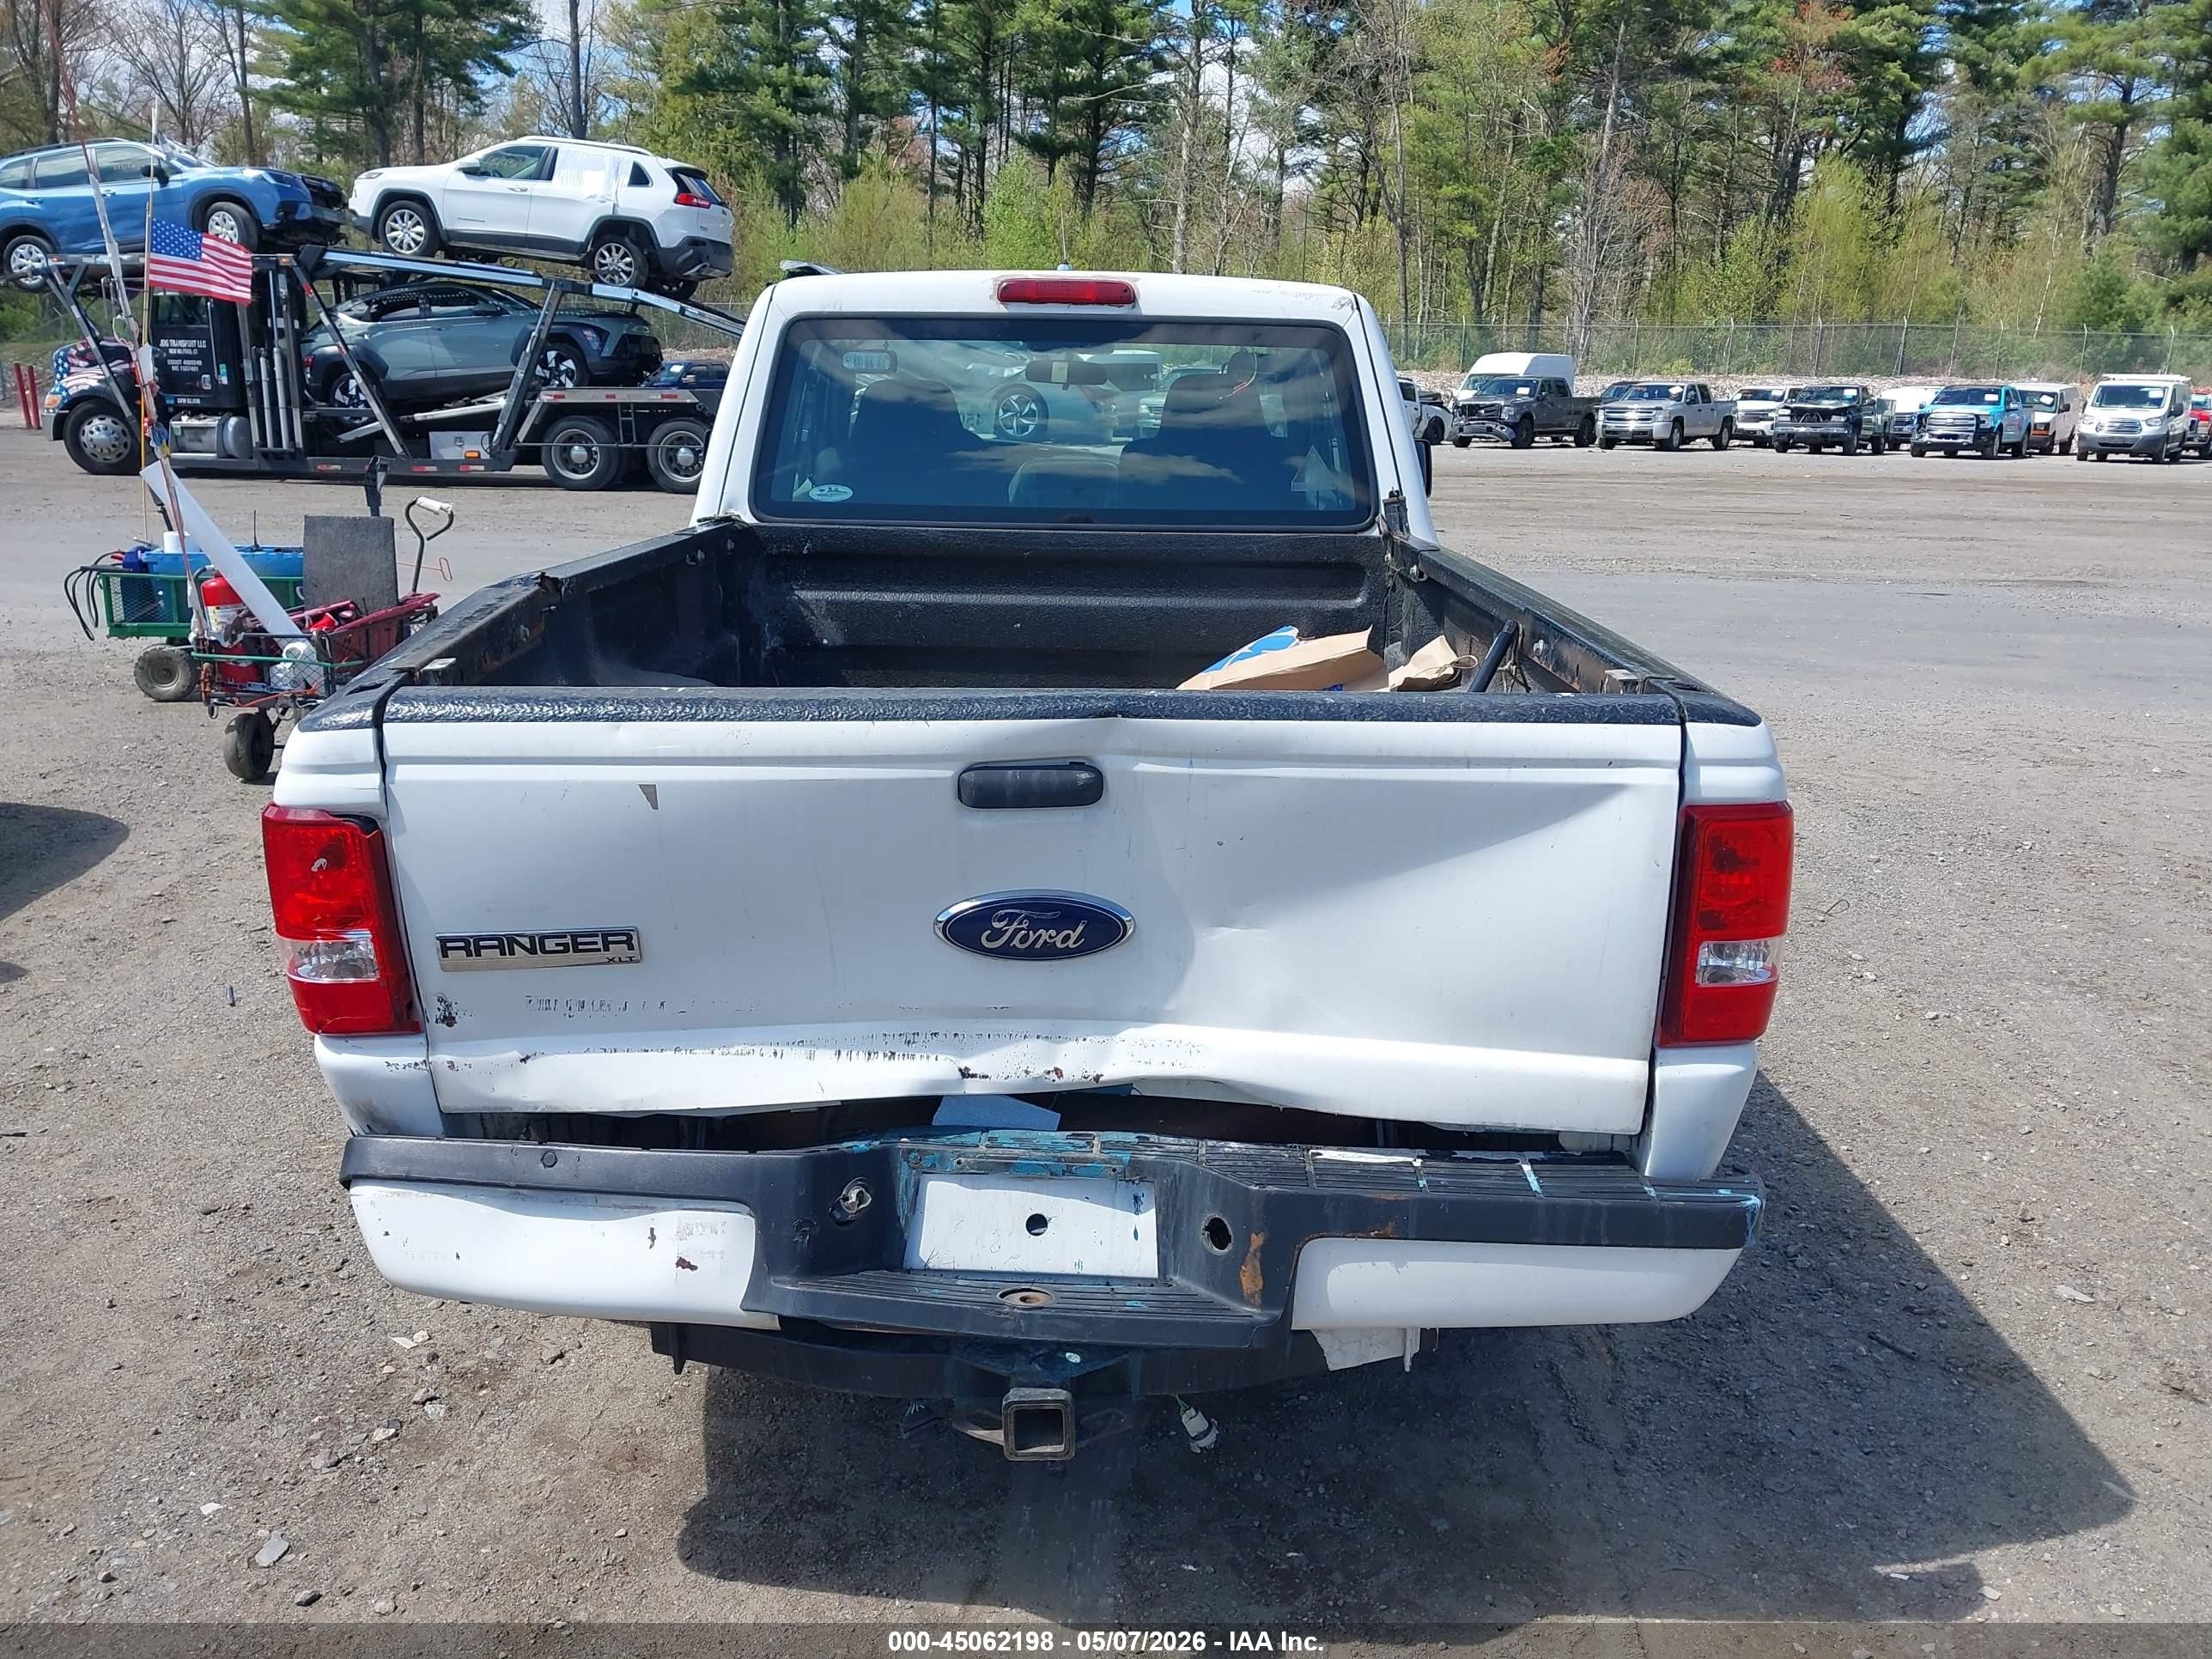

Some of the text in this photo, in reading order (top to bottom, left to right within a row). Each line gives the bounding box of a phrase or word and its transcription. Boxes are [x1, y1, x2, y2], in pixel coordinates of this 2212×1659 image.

[169, 338, 197, 348] TRANSPORT
[197, 339, 207, 348] LLC
[981, 908, 1088, 949] Ford
[439, 932, 635, 958] RANGER
